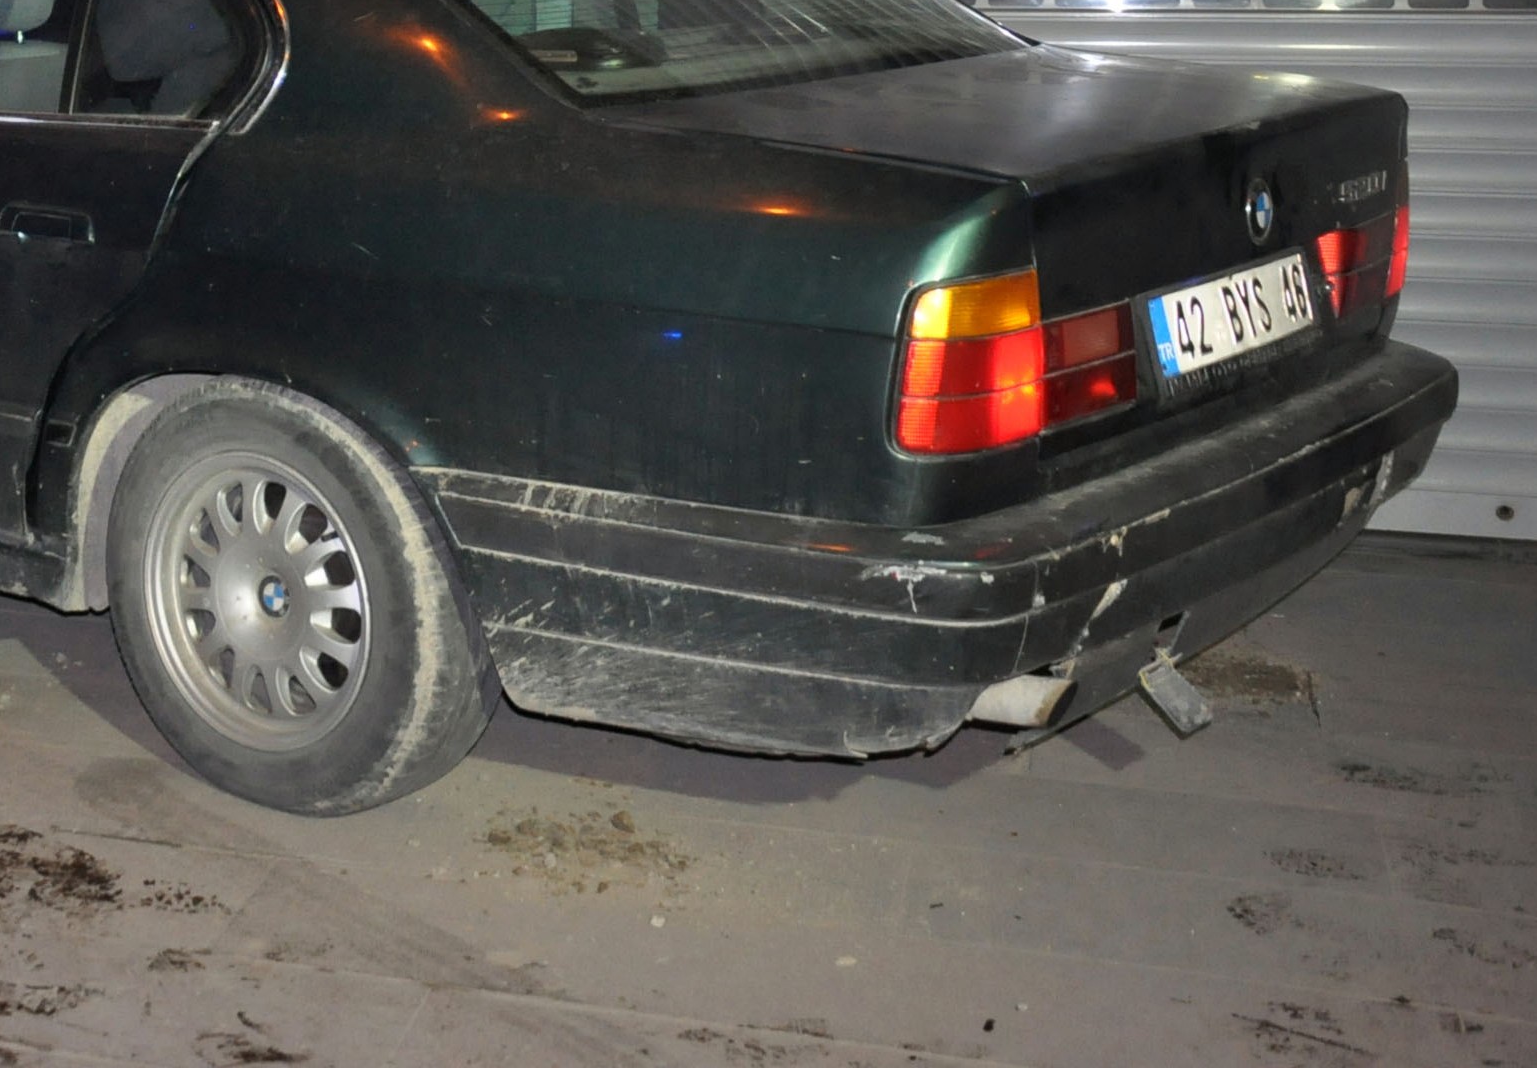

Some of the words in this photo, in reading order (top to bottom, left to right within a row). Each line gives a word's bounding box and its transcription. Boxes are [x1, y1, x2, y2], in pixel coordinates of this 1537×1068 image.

[1157, 343, 1175, 361] TR
[1176, 296, 1214, 358] 42
[1221, 277, 1272, 345] BYS
